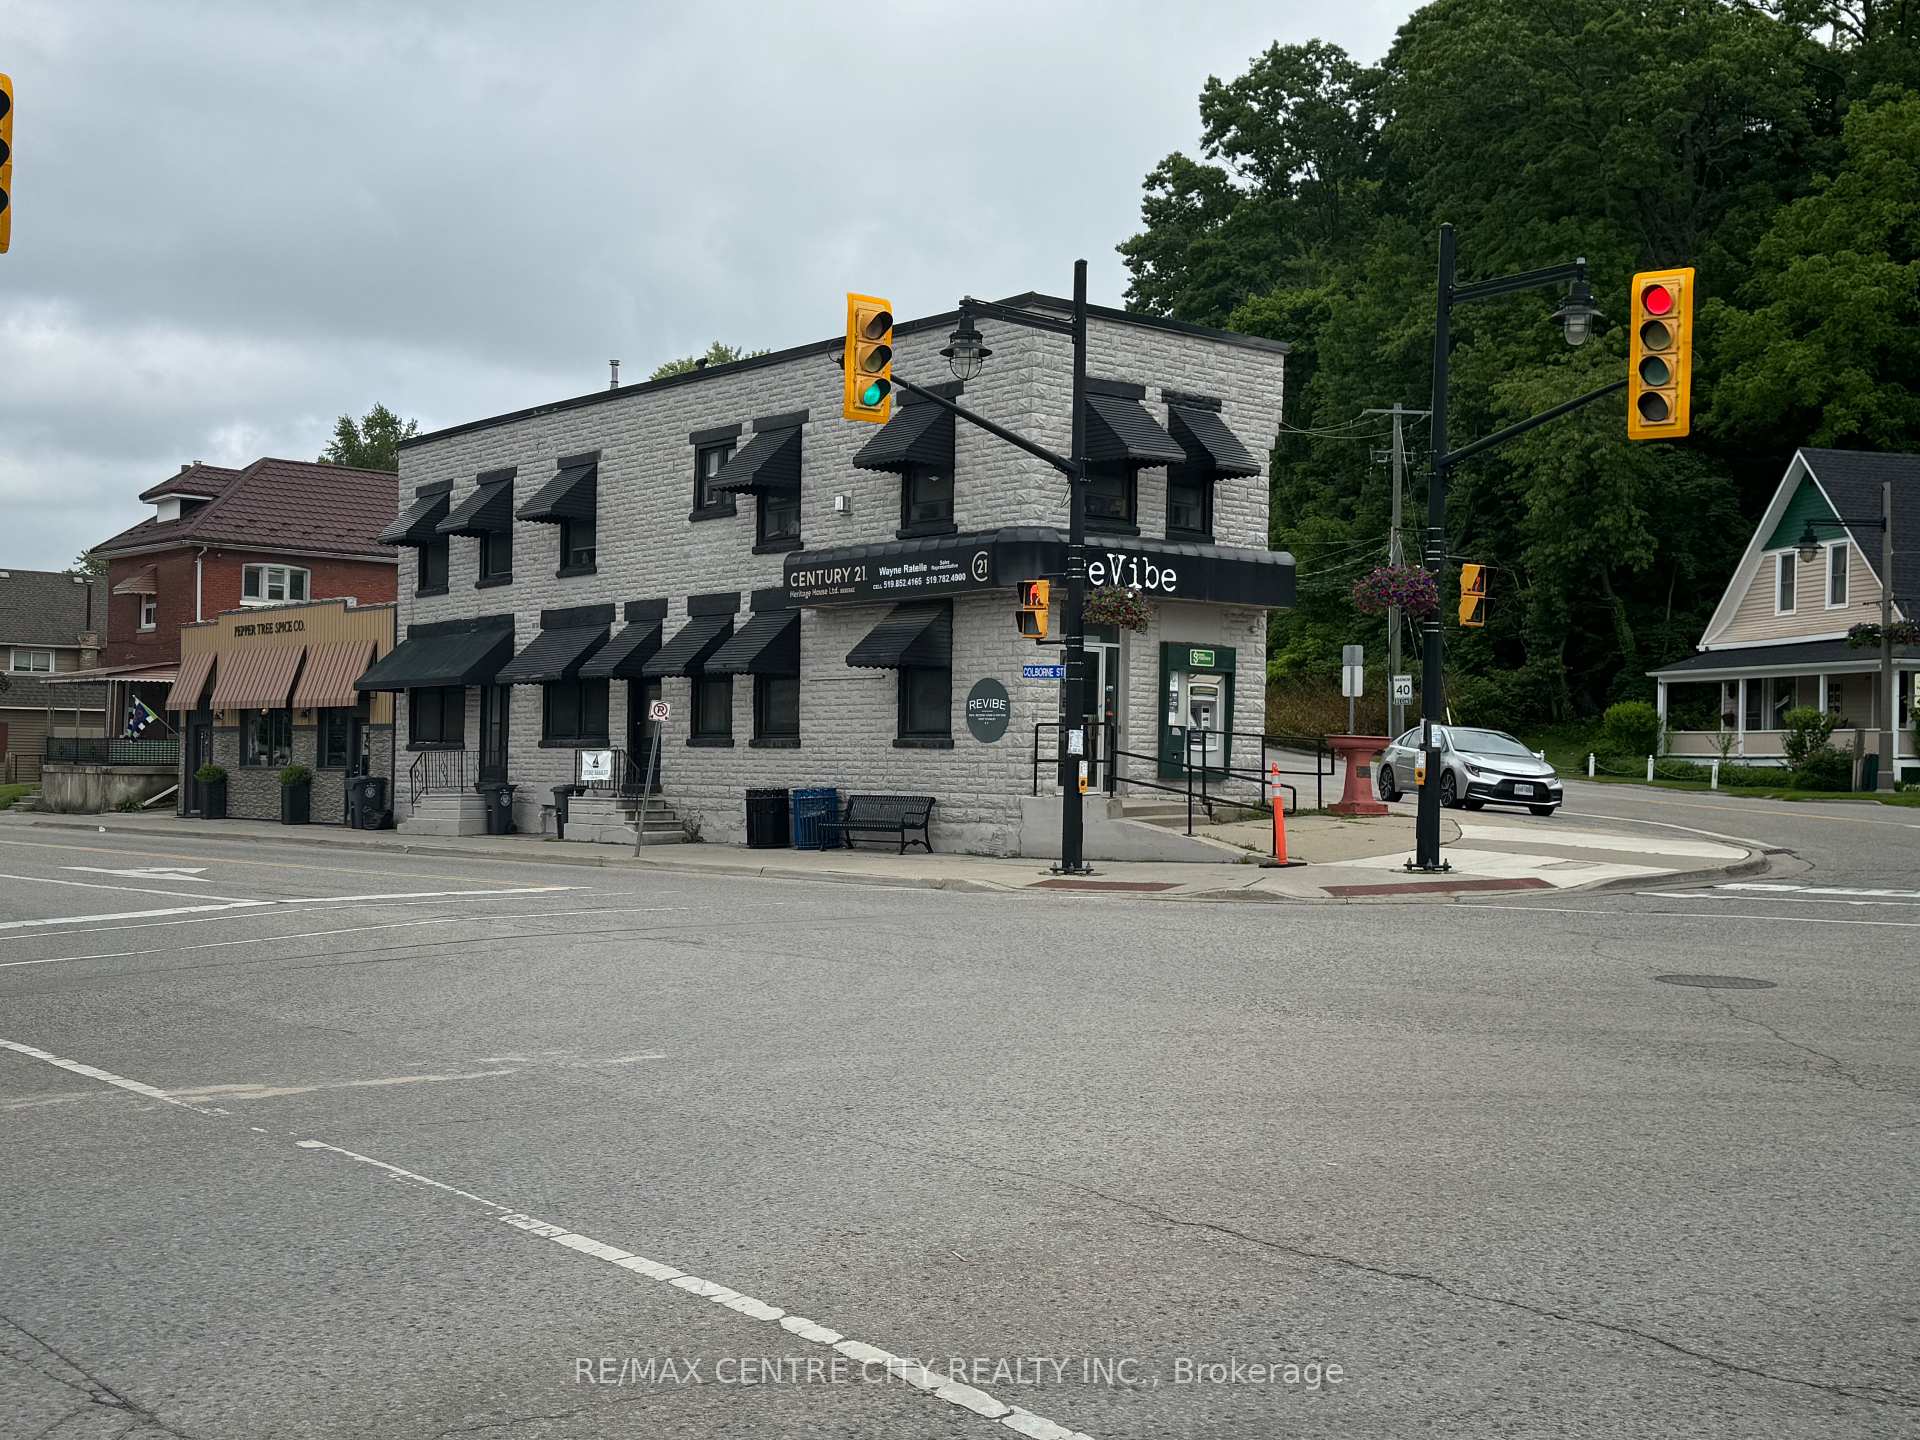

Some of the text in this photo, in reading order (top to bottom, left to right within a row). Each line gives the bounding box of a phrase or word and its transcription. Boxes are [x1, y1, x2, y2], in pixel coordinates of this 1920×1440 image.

[790, 565, 867, 587] CENTURY 21
[879, 562, 928, 577] Wayne Ratelle
[1083, 553, 1177, 592] eVibe
[789, 589, 812, 599] Heritage
[812, 587, 828, 596] House
[828, 586, 839, 595] Ltd.
[234, 619, 306, 637] PEPPER TREE SPICE CO.
[1023, 667, 1064, 677] COLBORNE ST
[1396, 684, 1410, 695] 40
[969, 698, 1007, 710] REVIBE
